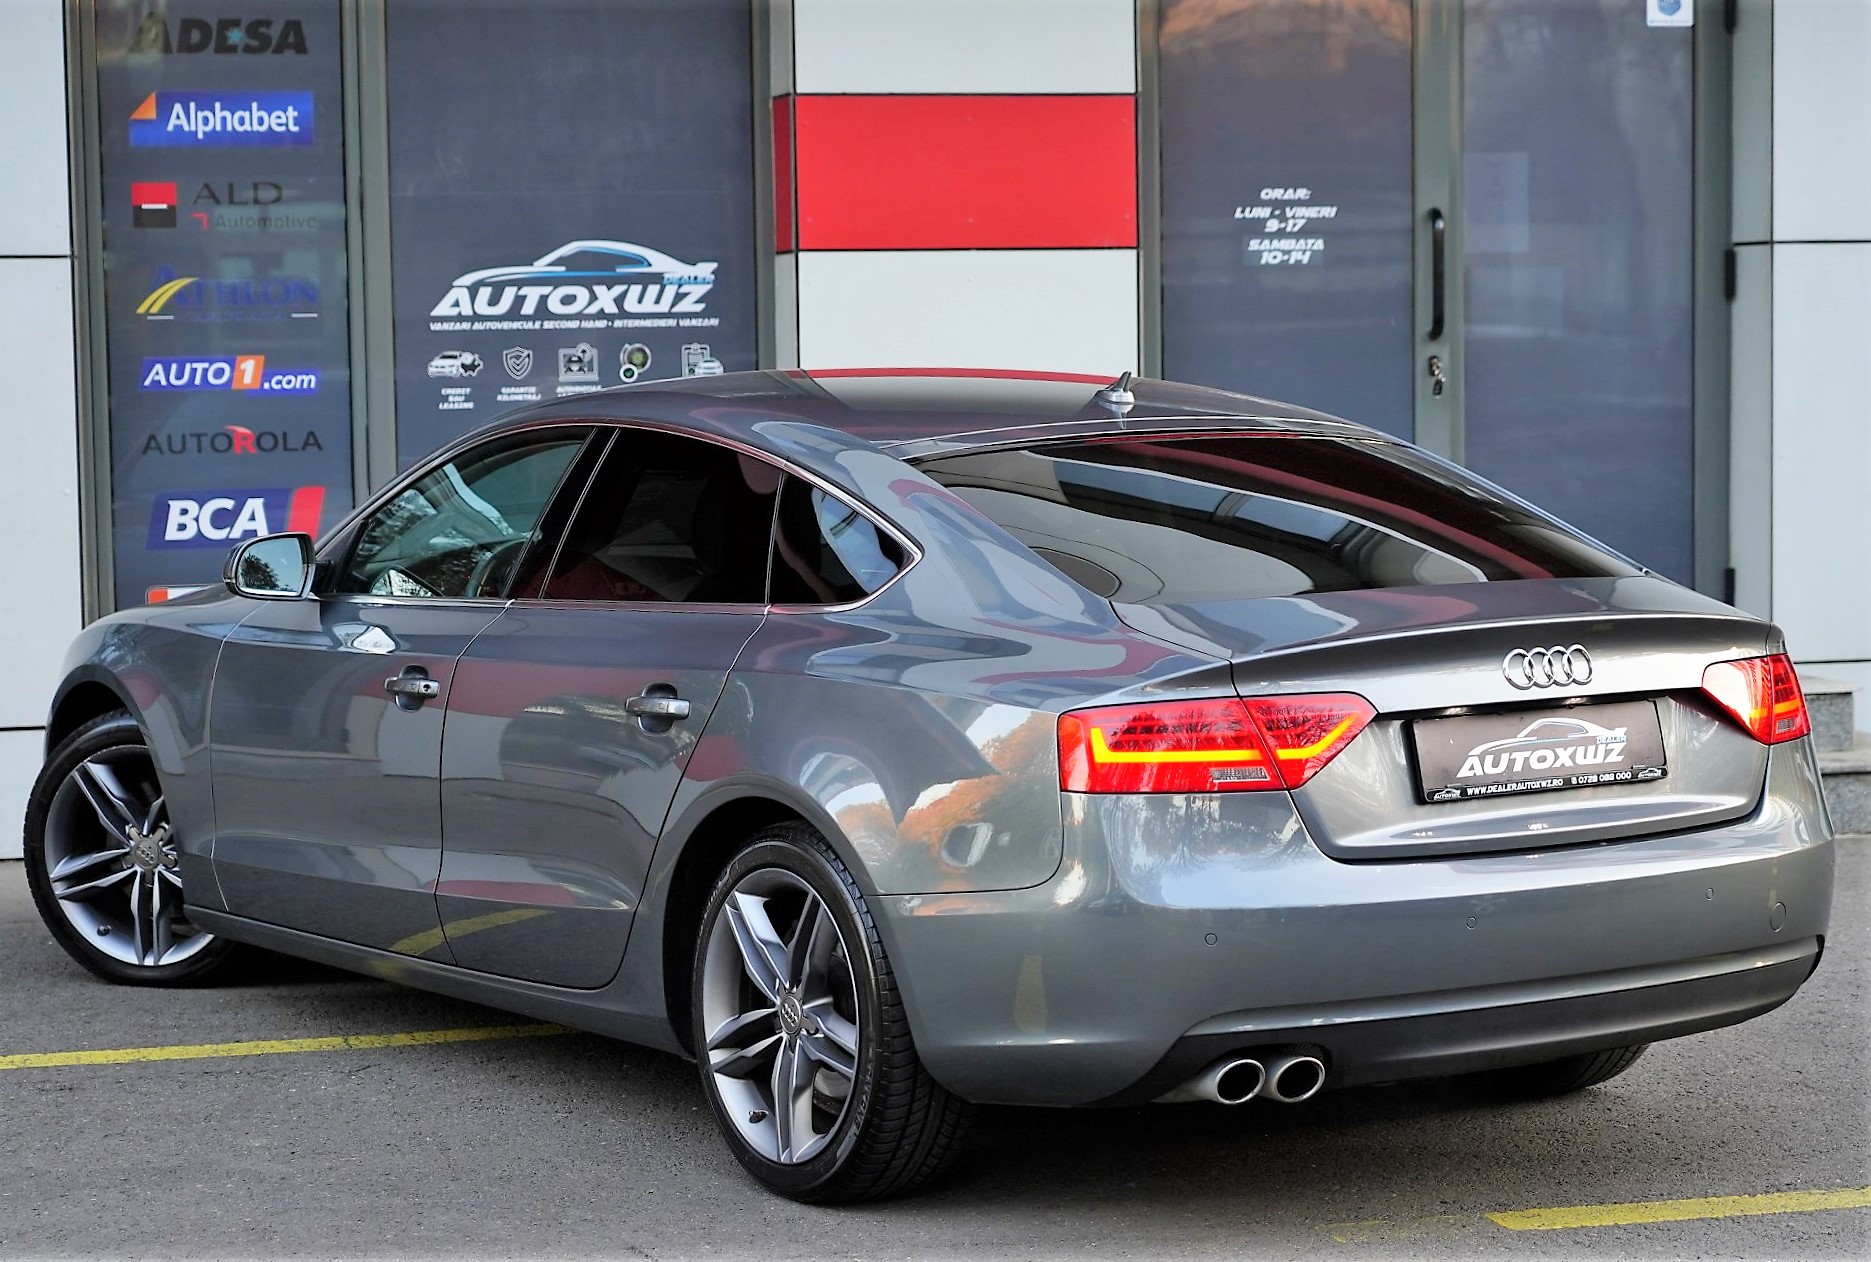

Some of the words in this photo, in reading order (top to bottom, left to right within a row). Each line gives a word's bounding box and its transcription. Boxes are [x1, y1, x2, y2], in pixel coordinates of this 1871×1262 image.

[130, 12, 308, 54] ADESA
[166, 101, 300, 139] Alphabet
[193, 182, 283, 205] ALD
[1260, 188, 1312, 200] ORAR:
[1234, 206, 1272, 218] LUNI
[1285, 206, 1338, 218] VINERI
[214, 214, 317, 229] Automotive
[1264, 219, 1307, 232] 9-17
[1248, 239, 1324, 250] SAMBATA
[1260, 251, 1311, 264] 10-14
[430, 284, 713, 316] AUTOXWZ
[542, 320, 580, 330] SECOND
[142, 425, 323, 455] AUTOROLA
[164, 497, 269, 541] BCA
[1456, 743, 1627, 778] AUTOXWZ
[1616, 771, 1632, 780] 000
[1466, 778, 1564, 796] WWW.DEALERAUTOXWZ.RO
